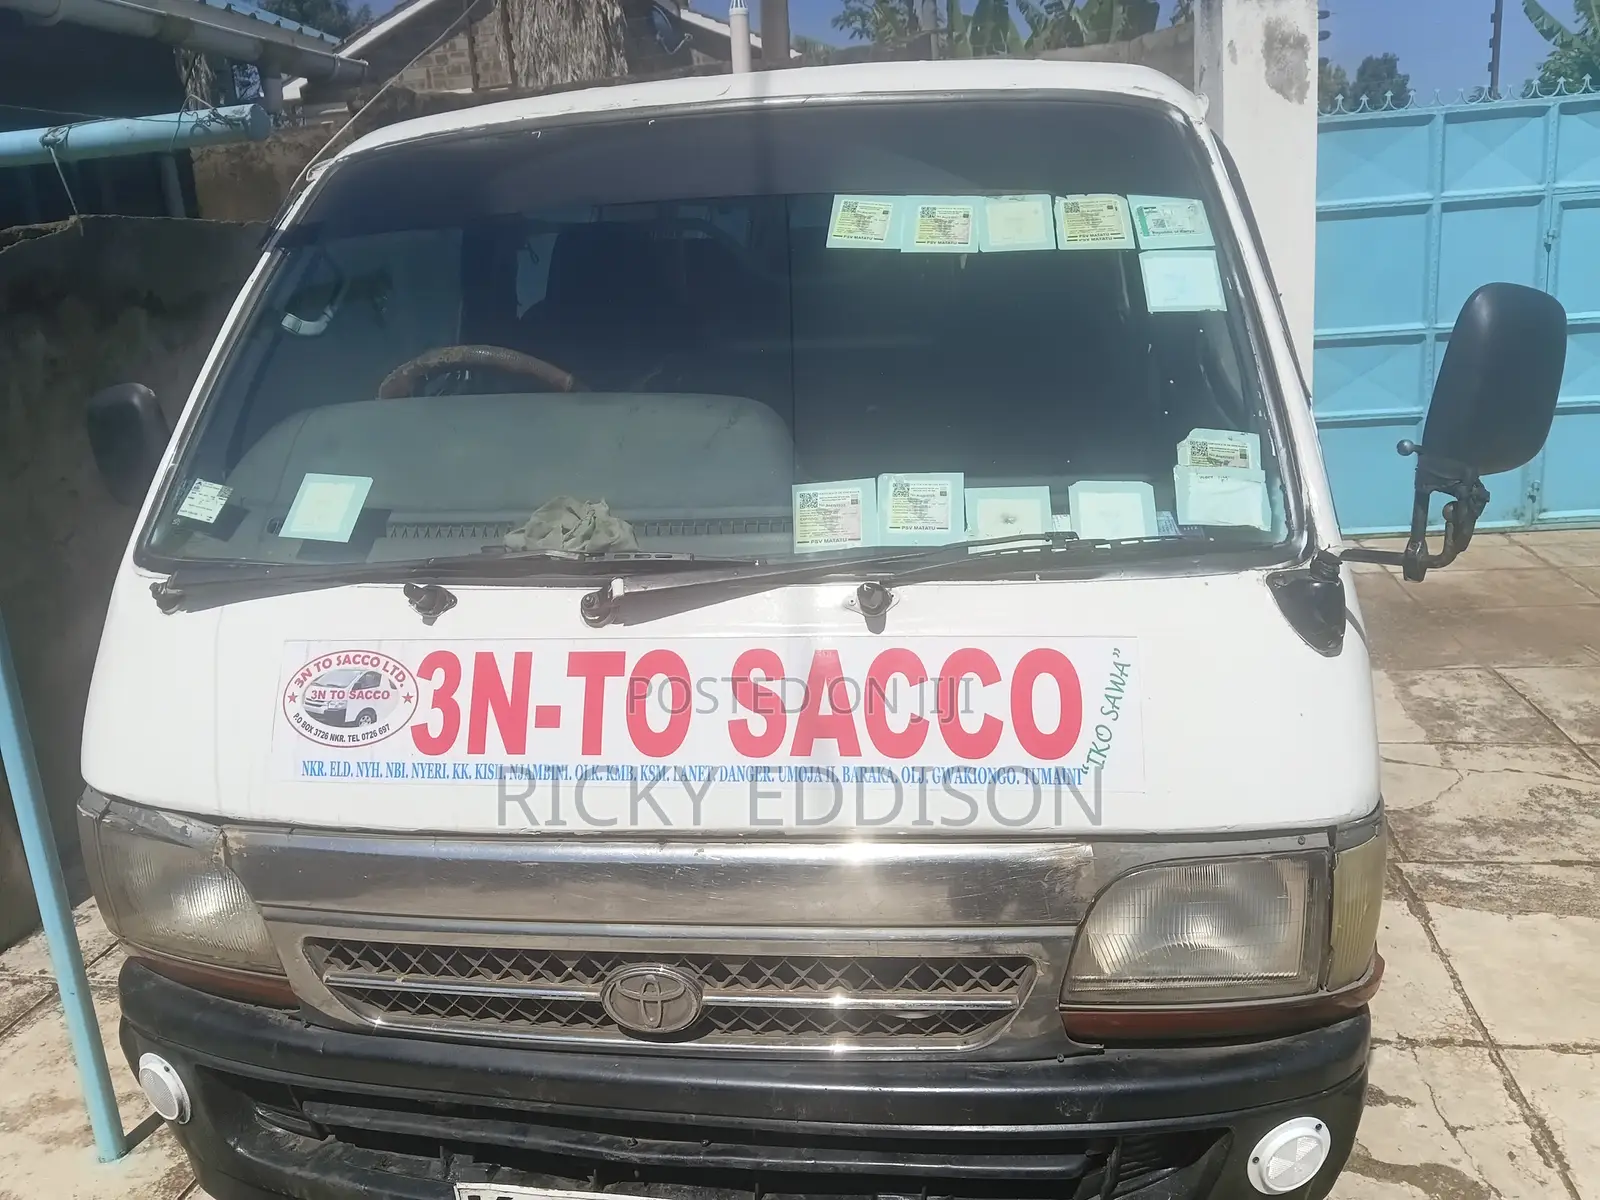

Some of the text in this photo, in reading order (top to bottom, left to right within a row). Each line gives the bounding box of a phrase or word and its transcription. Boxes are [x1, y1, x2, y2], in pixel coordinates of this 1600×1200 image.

[823, 536, 848, 544] MATATU
[294, 654, 407, 689] 3N TO SACCO LTD.
[311, 690, 391, 700] 3N TO SACCO
[410, 647, 1082, 760] 3N-TO SACCO
[301, 721, 315, 734] BOX
[313, 727, 330, 741] 3726
[329, 733, 346, 743] NKR.
[347, 733, 361, 743] TEL
[361, 730, 378, 742] 0726
[301, 760, 327, 777] NKR.
[329, 761, 353, 777] ELD.
[356, 761, 383, 778] NYH.
[385, 762, 409, 778] NBI.
[411, 762, 449, 779] NYERI.
[452, 762, 472, 779] KK.
[640, 764, 670, 782] KSM.
[719, 765, 775, 782] DANGER.
